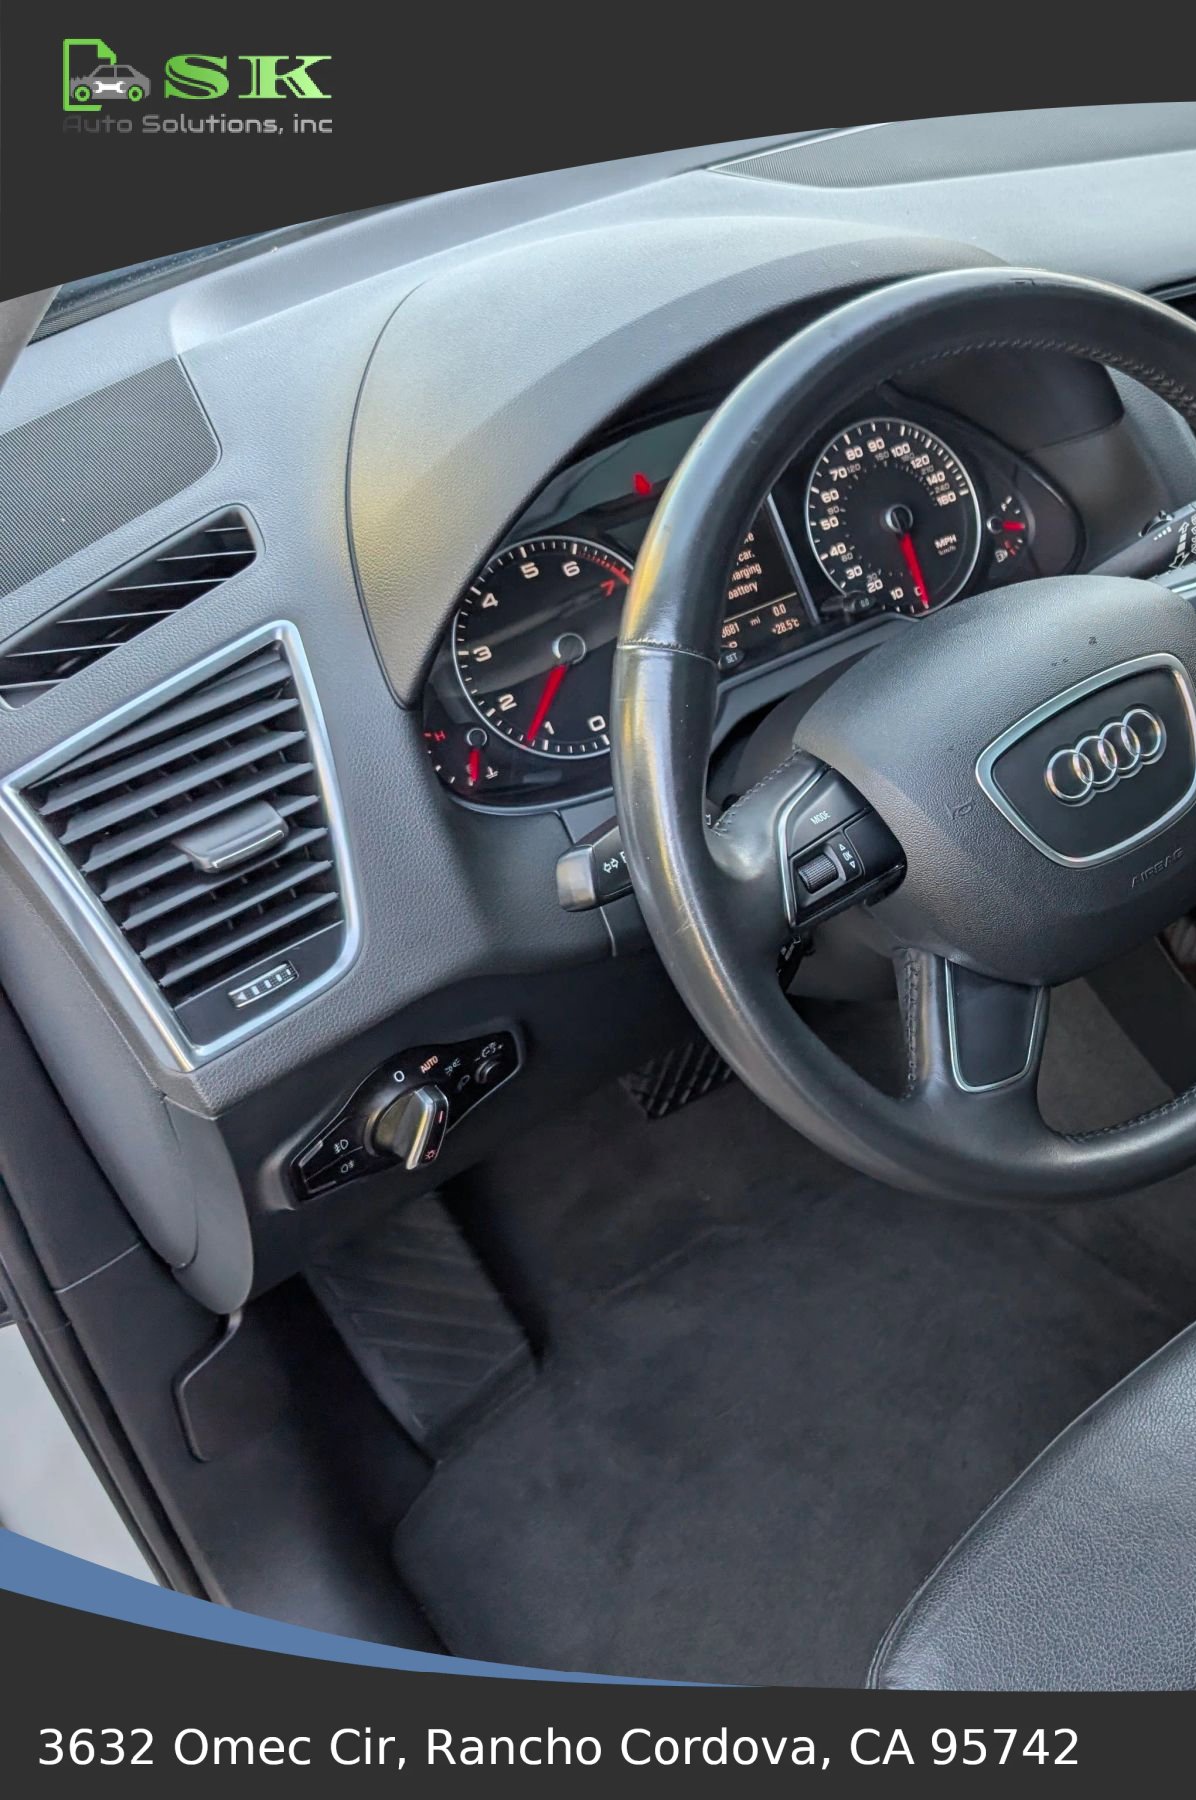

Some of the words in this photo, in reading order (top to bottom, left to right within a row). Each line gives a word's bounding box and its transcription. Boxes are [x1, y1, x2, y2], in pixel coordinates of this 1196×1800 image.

[867, 437, 885, 453] 90
[891, 442, 911, 458] 100
[845, 446, 864, 461] 80
[910, 454, 930, 470] 120
[829, 467, 848, 482] 70
[926, 470, 946, 486] 140
[820, 488, 840, 504] 60
[936, 491, 957, 507] 160
[820, 515, 840, 531] 50
[829, 542, 847, 558] 40
[934, 534, 957, 550] MPH
[520, 562, 539, 580] 5
[562, 561, 581, 577] 6
[845, 565, 863, 580] 30
[601, 579, 615, 596] 7
[866, 579, 884, 594] 20
[890, 587, 905, 600] 10
[482, 593, 498, 609] 4
[772, 603, 786, 617] 0.0
[473, 645, 492, 662] 3
[726, 652, 738, 664] SET
[499, 693, 518, 712] 2
[544, 721, 555, 735] 1
[588, 715, 606, 732] 0
[809, 810, 831, 825] MODE
[420, 1055, 439, 1074] AUTO
